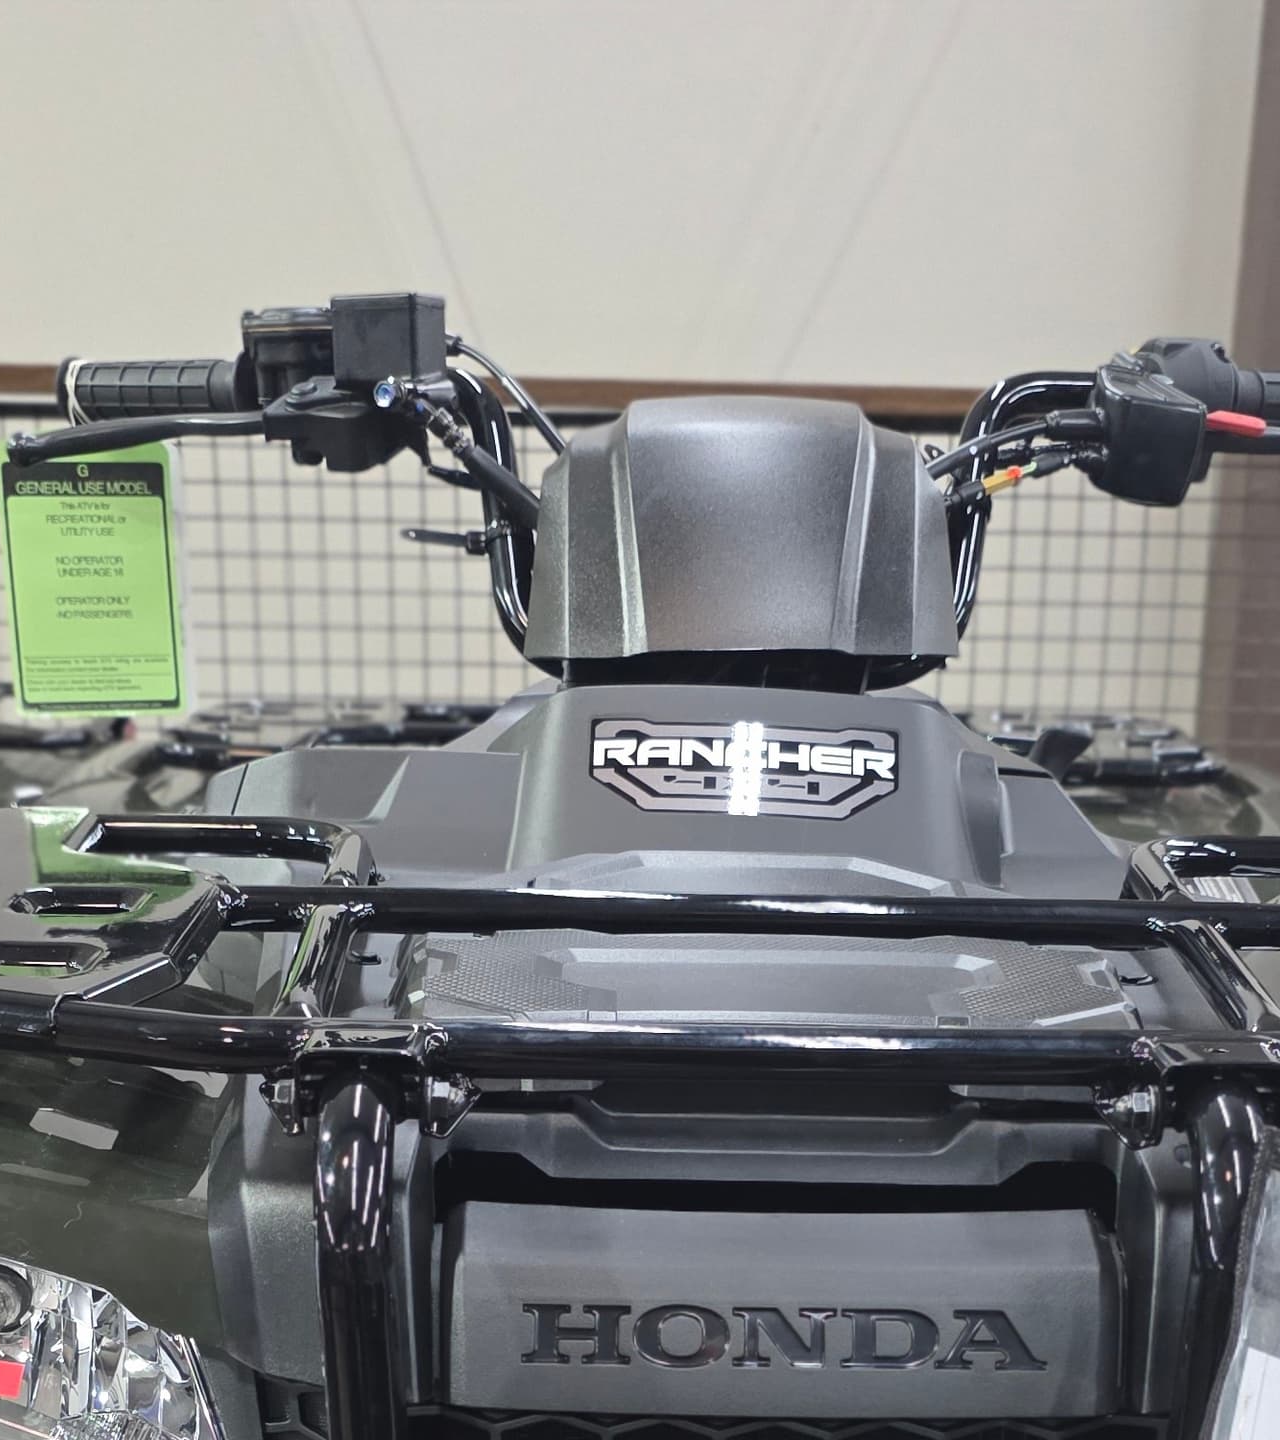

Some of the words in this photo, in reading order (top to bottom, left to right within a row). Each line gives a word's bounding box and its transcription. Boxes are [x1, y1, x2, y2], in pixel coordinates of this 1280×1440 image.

[76, 464, 89, 477] G
[15, 481, 77, 495] GENERAL
[78, 481, 104, 495] USE
[106, 481, 152, 495] MODEL
[46, 514, 117, 524] RECREATIONAL
[60, 527, 94, 536] UTILITY
[95, 527, 115, 537] USE
[55, 556, 71, 565] NO
[71, 556, 124, 565] OPERATOR
[57, 567, 91, 577] UNDER
[92, 567, 112, 577] AGE
[55, 596, 105, 606] OPERATOR
[106, 596, 131, 606] ONLY
[521, 1303, 1049, 1372] HONDA
